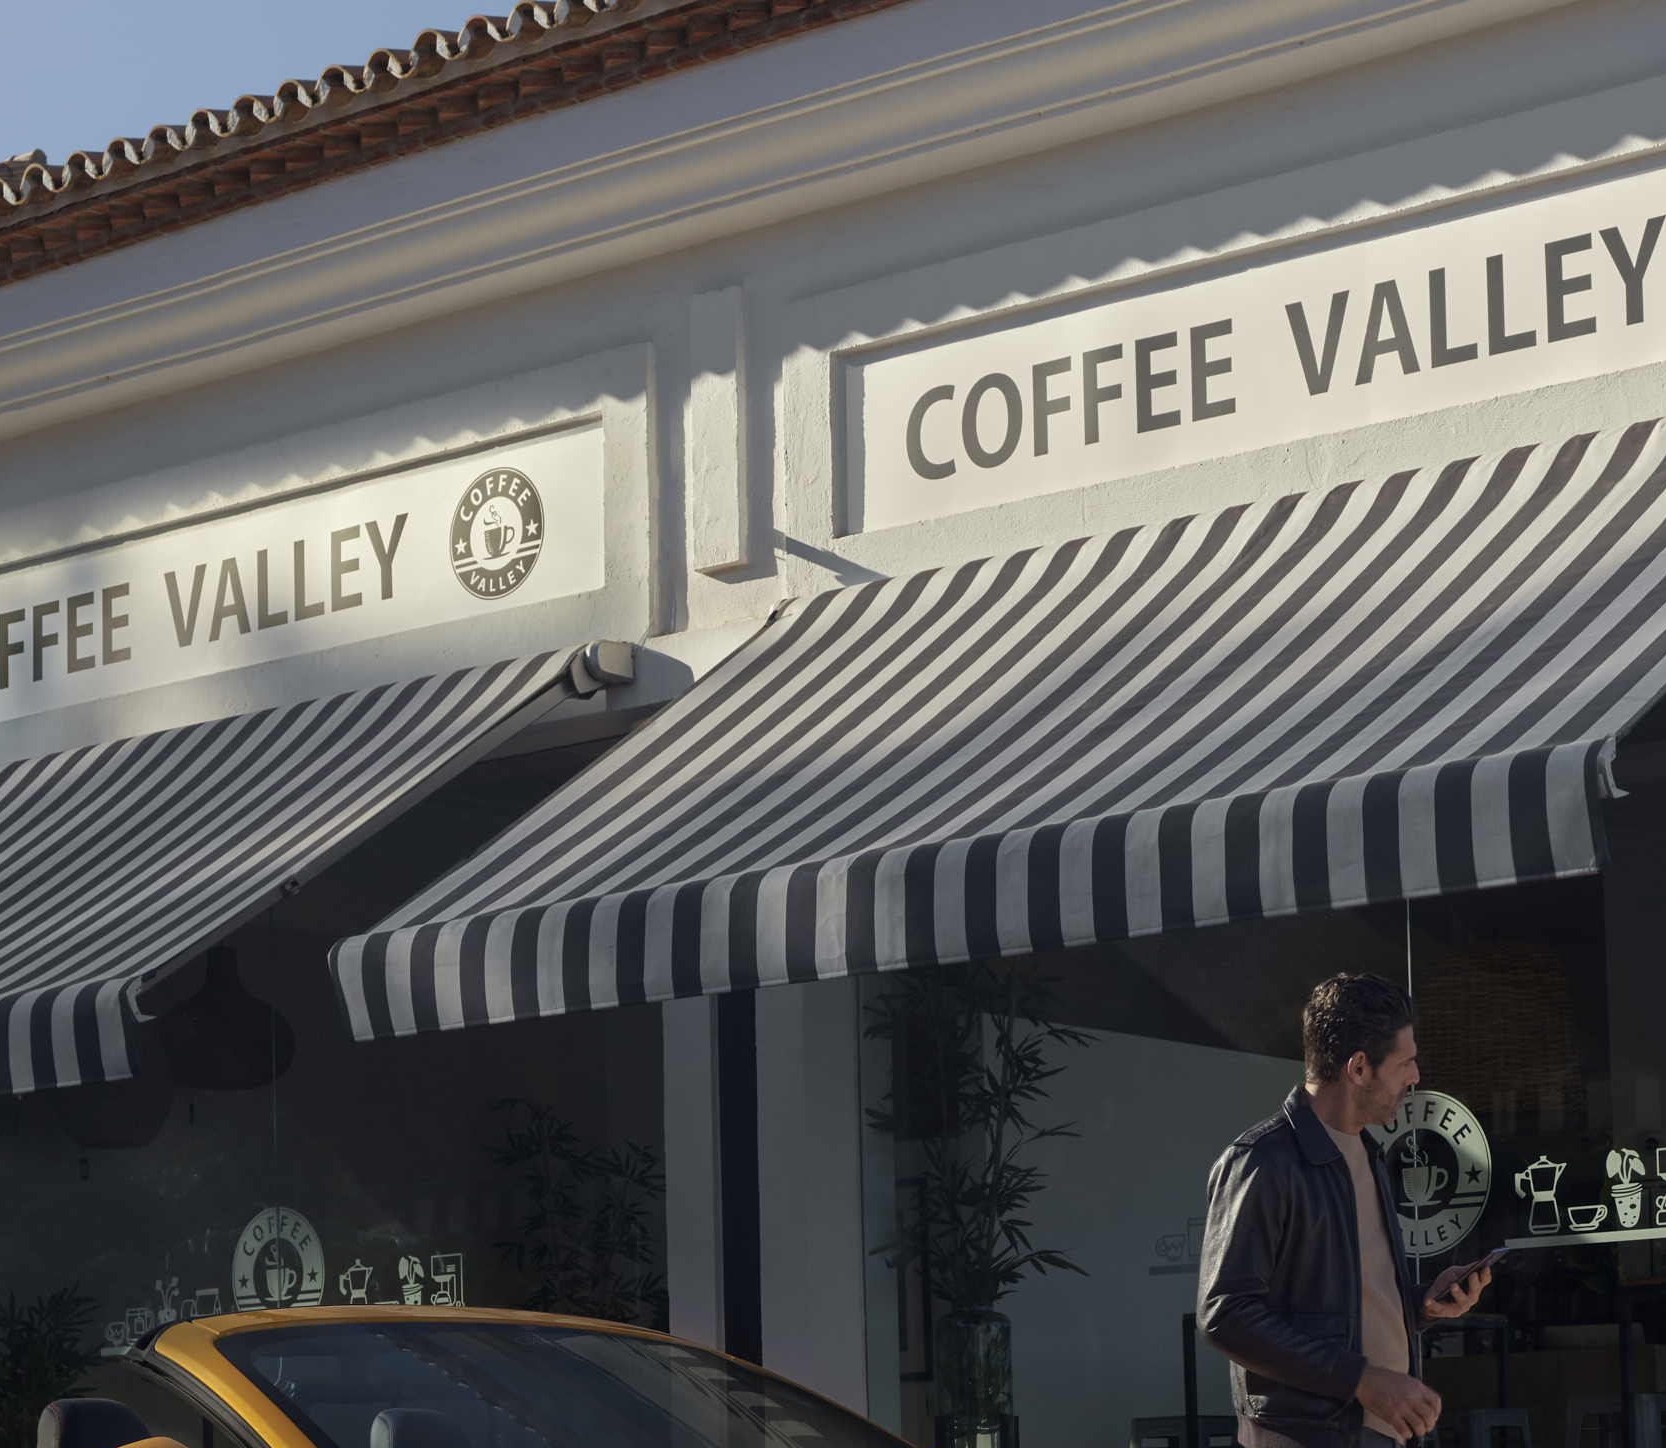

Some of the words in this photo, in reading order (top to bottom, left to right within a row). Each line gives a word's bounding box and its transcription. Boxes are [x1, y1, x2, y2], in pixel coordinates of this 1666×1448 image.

[906, 318, 1237, 481] COFFEE
[1284, 215, 1666, 397] VALLEY
[460, 474, 531, 522] COFFEE
[164, 513, 409, 648] VALLEY
[470, 560, 526, 592] VALLEY
[243, 1215, 312, 1256] COFFEE
